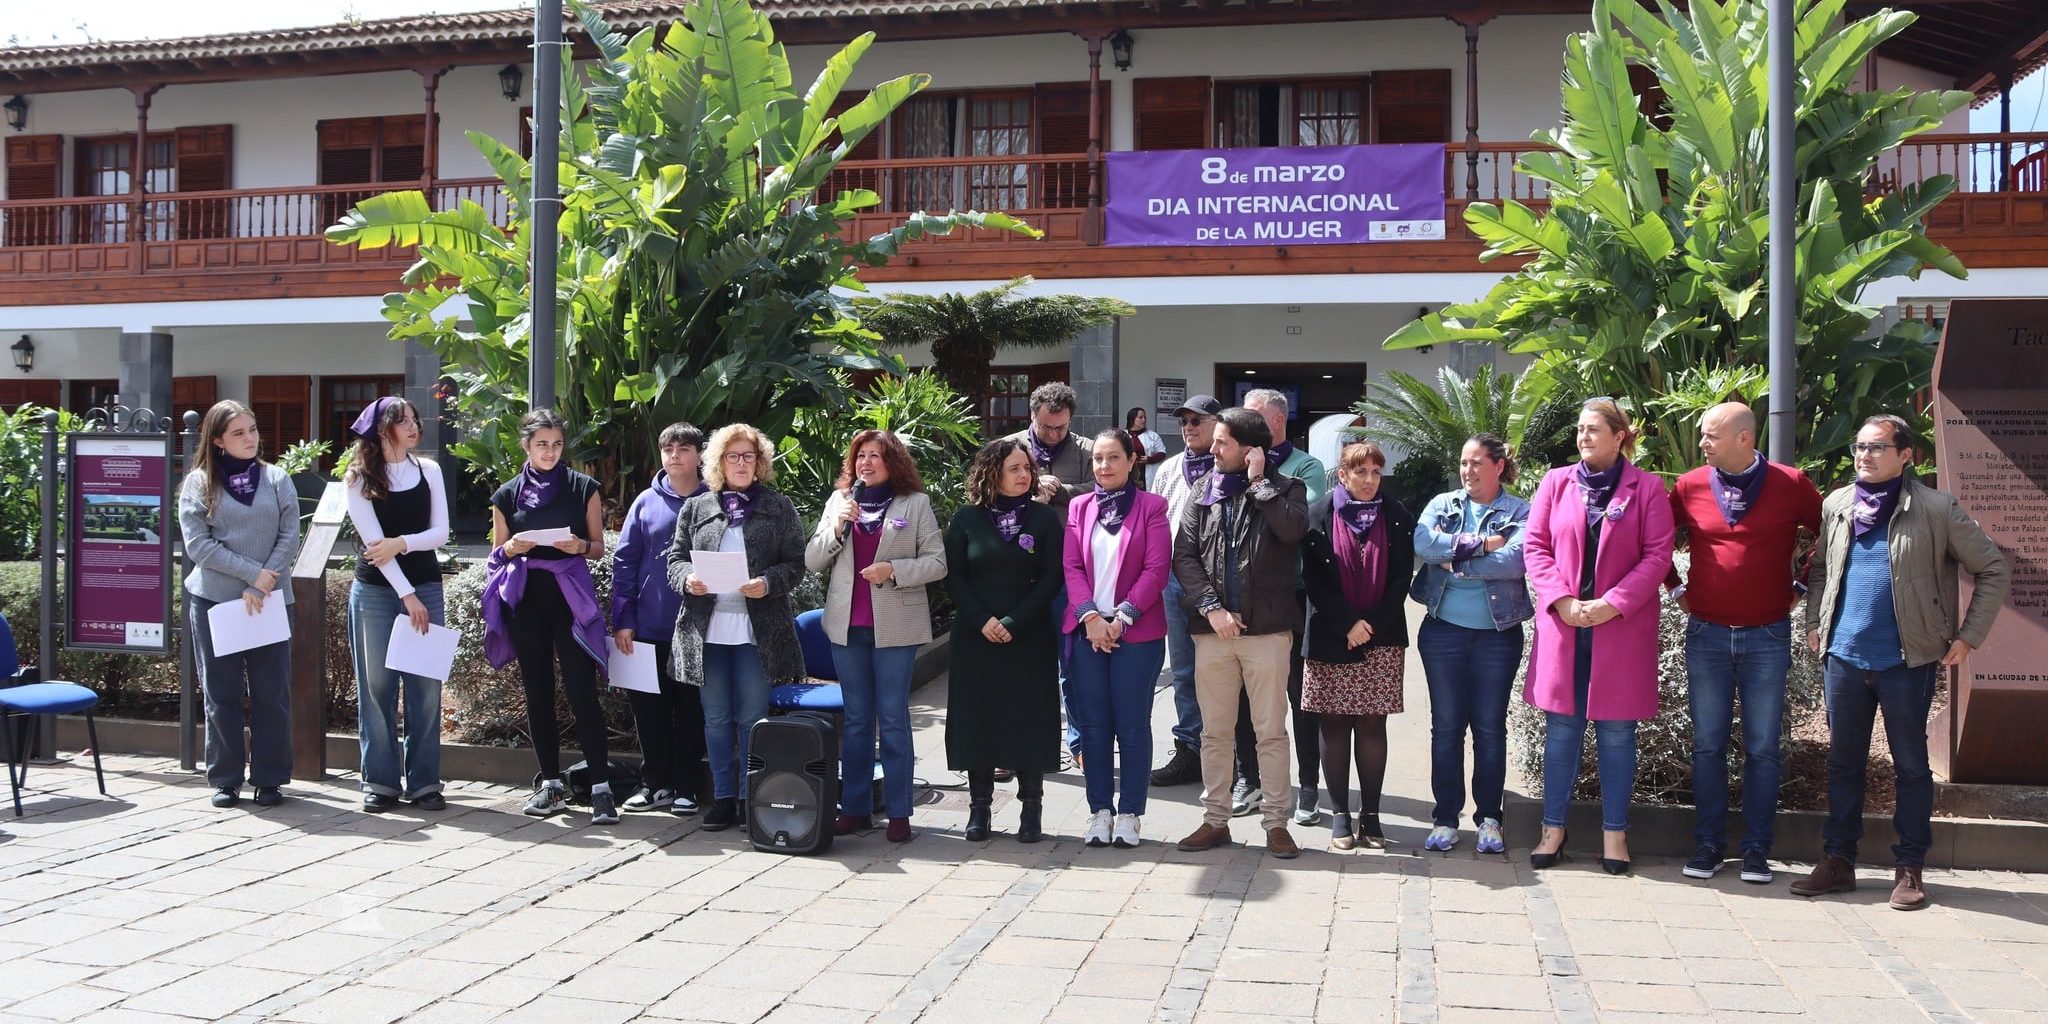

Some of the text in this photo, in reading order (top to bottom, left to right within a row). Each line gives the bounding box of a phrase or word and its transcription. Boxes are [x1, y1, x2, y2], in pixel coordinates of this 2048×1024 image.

[1200, 157, 1345, 184] 8 de marzo
[1148, 193, 1400, 216] DIA INTERNACIONAL
[1196, 220, 1342, 241] DE LA MUJER
[1984, 452, 1998, 461] Rey
[2015, 599, 2040, 607] Madrid
